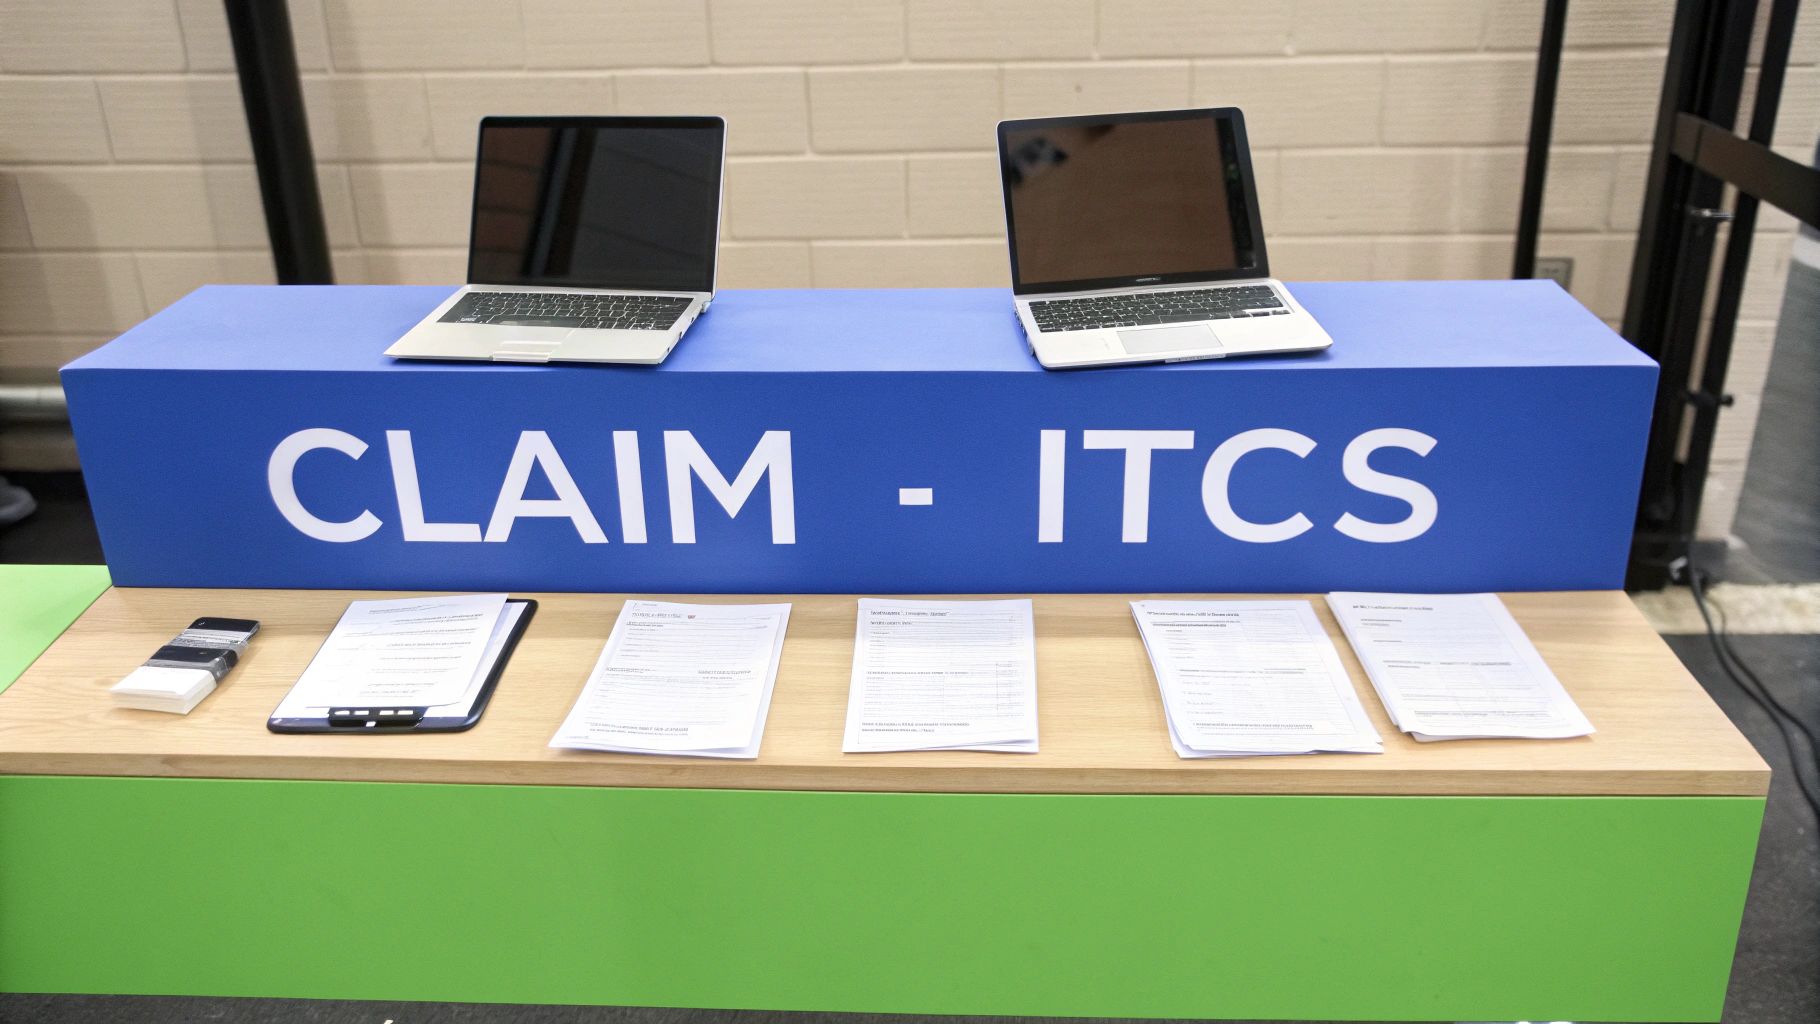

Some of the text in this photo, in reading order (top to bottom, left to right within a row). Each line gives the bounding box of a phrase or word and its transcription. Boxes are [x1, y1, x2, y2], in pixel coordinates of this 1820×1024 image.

[267, 427, 1440, 545] CLAIM - ITCS
